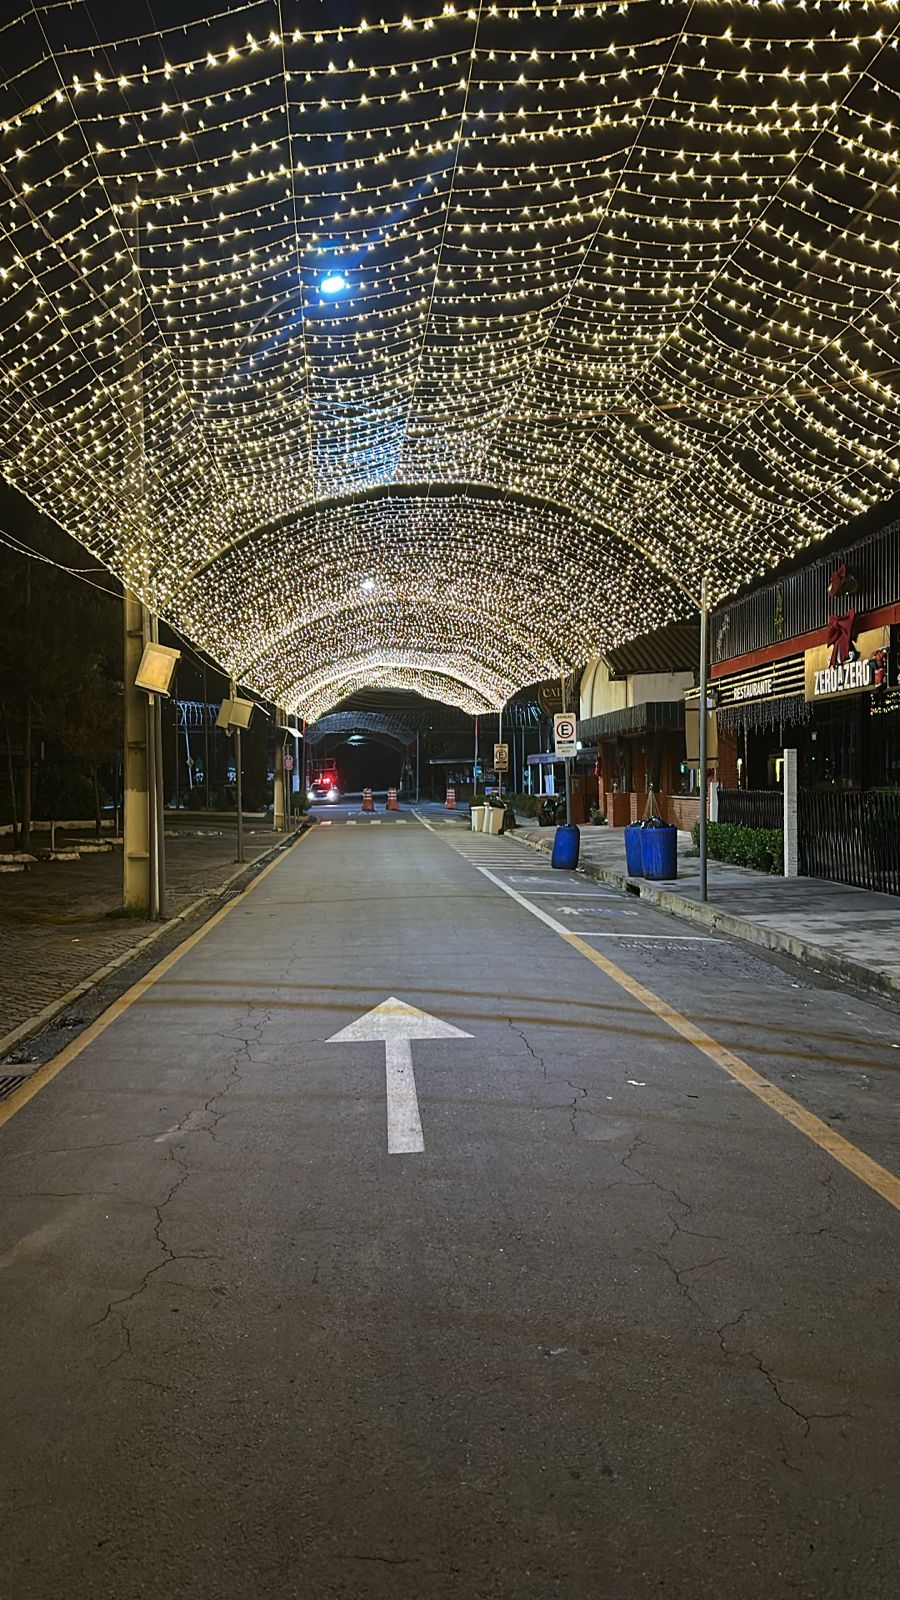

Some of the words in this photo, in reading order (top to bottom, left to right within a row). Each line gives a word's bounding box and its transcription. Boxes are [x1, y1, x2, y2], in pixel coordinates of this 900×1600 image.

[813, 664, 837, 696] ZERO
[843, 658, 870, 690] ZERO
[733, 678, 773, 701] RESTAURANTE
[561, 724, 570, 736] E
